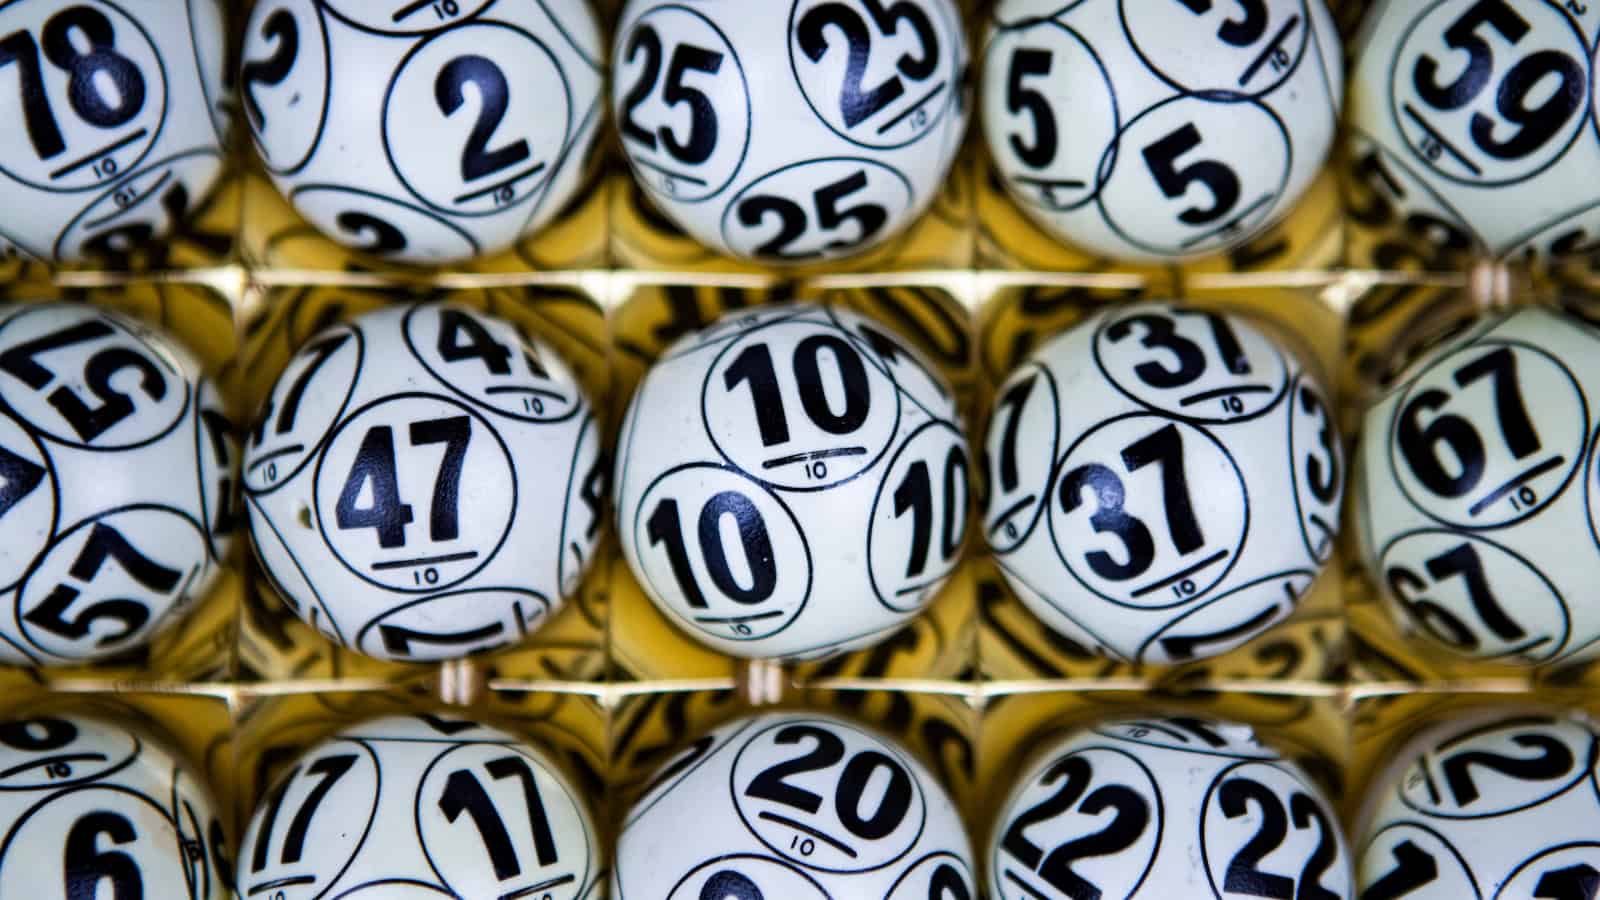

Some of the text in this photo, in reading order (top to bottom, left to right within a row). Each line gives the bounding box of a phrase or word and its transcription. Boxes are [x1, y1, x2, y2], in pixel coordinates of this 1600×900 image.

[0, 5, 146, 160] 78
[434, 55, 531, 183] 2
[620, 24, 724, 165] 25
[797, 0, 939, 129] 25
[1007, 47, 1059, 169] 5
[1413, 0, 1586, 161] 59
[93, 157, 117, 180] 10
[737, 170, 887, 259] 25
[1141, 122, 1241, 225] 5
[0, 319, 167, 443] 57
[522, 397, 545, 416] 10
[723, 334, 871, 448] 10
[1221, 396, 1244, 414] 10
[1397, 347, 1543, 499] 67
[262, 462, 277, 483] 10
[335, 415, 473, 549] 47
[804, 461, 828, 480] 10
[1059, 422, 1206, 583] 37
[1300, 385, 1337, 506] 3
[1508, 485, 1539, 513] 10
[646, 491, 778, 609] 10
[894, 443, 969, 579] 10
[23, 521, 184, 649] 57
[413, 566, 439, 586] 10
[1172, 578, 1197, 598] 10
[1386, 541, 1528, 651] 67
[44, 762, 73, 779] 10
[438, 755, 559, 882] 17
[744, 725, 914, 841] 20
[1001, 755, 1151, 900] 22
[790, 834, 816, 857] 10
[1218, 777, 1343, 900] 22
